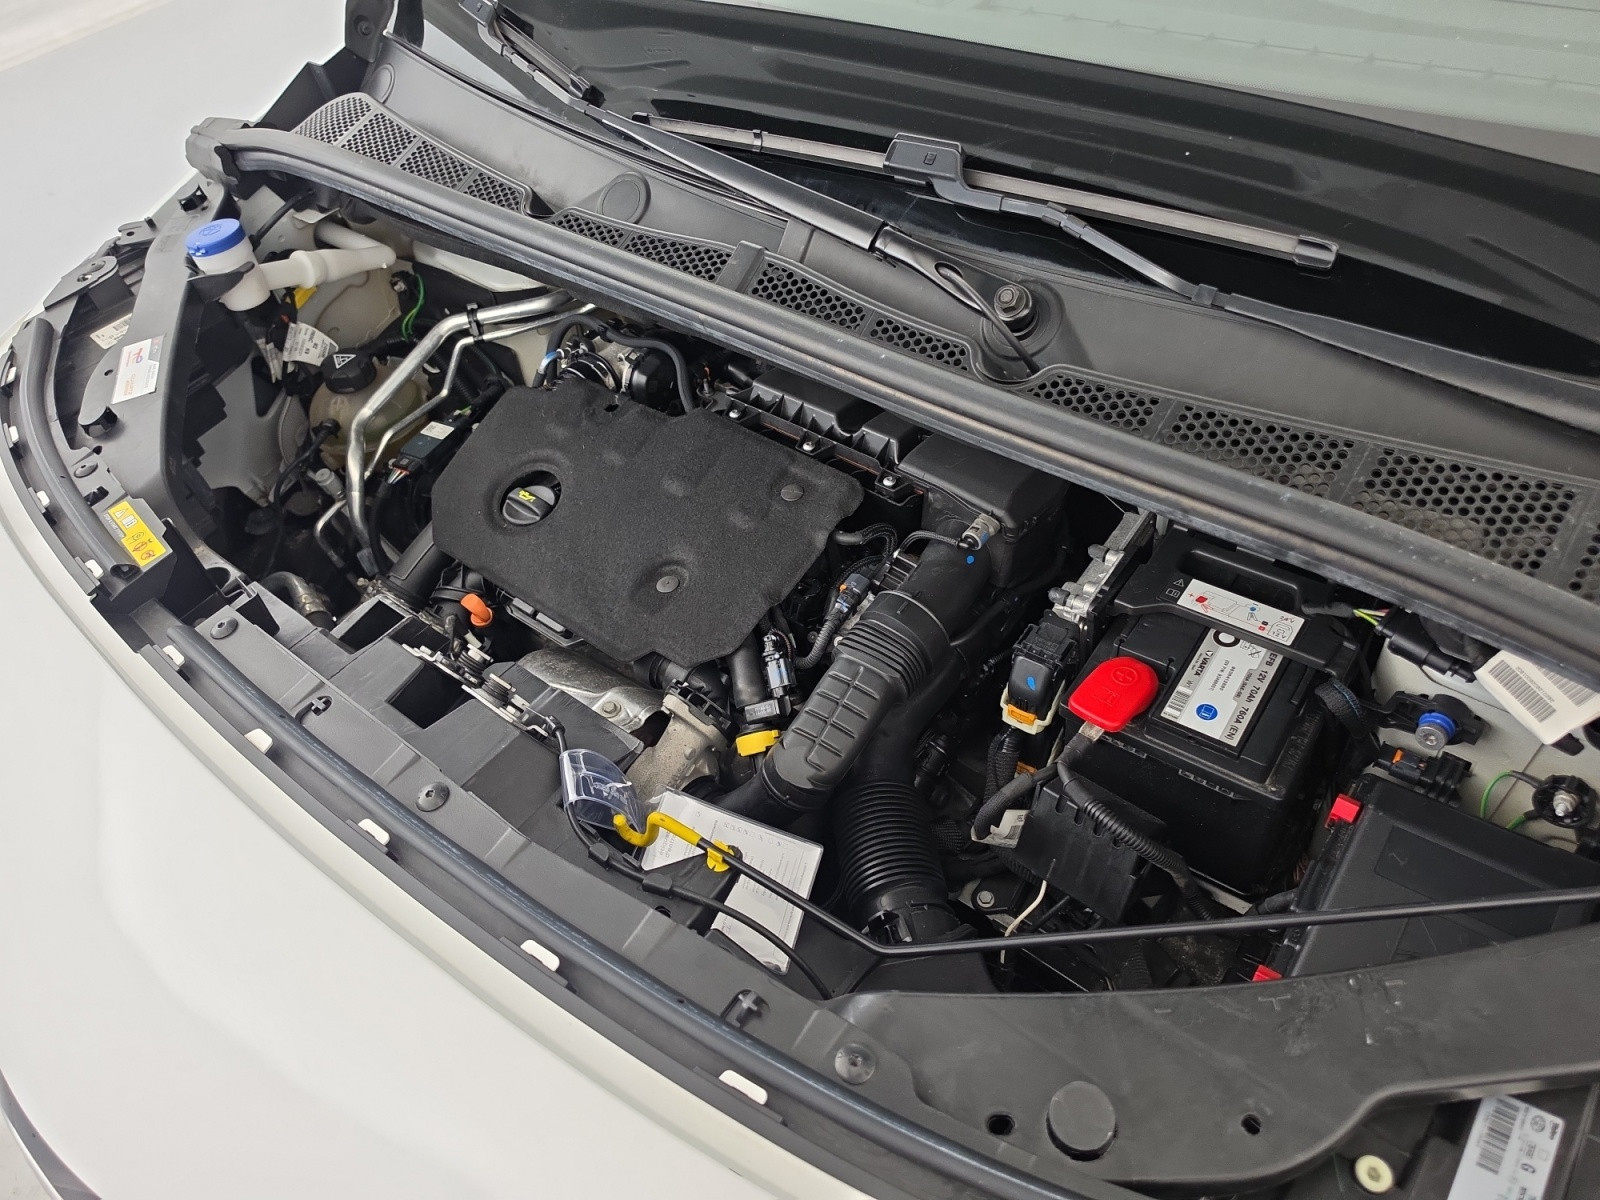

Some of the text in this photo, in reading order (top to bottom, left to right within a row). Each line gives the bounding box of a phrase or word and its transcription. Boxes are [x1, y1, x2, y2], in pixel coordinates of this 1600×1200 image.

[1194, 656, 1209, 678] VARTA
[1224, 652, 1277, 741] EFB 12V 70Ah 760A (EN)
